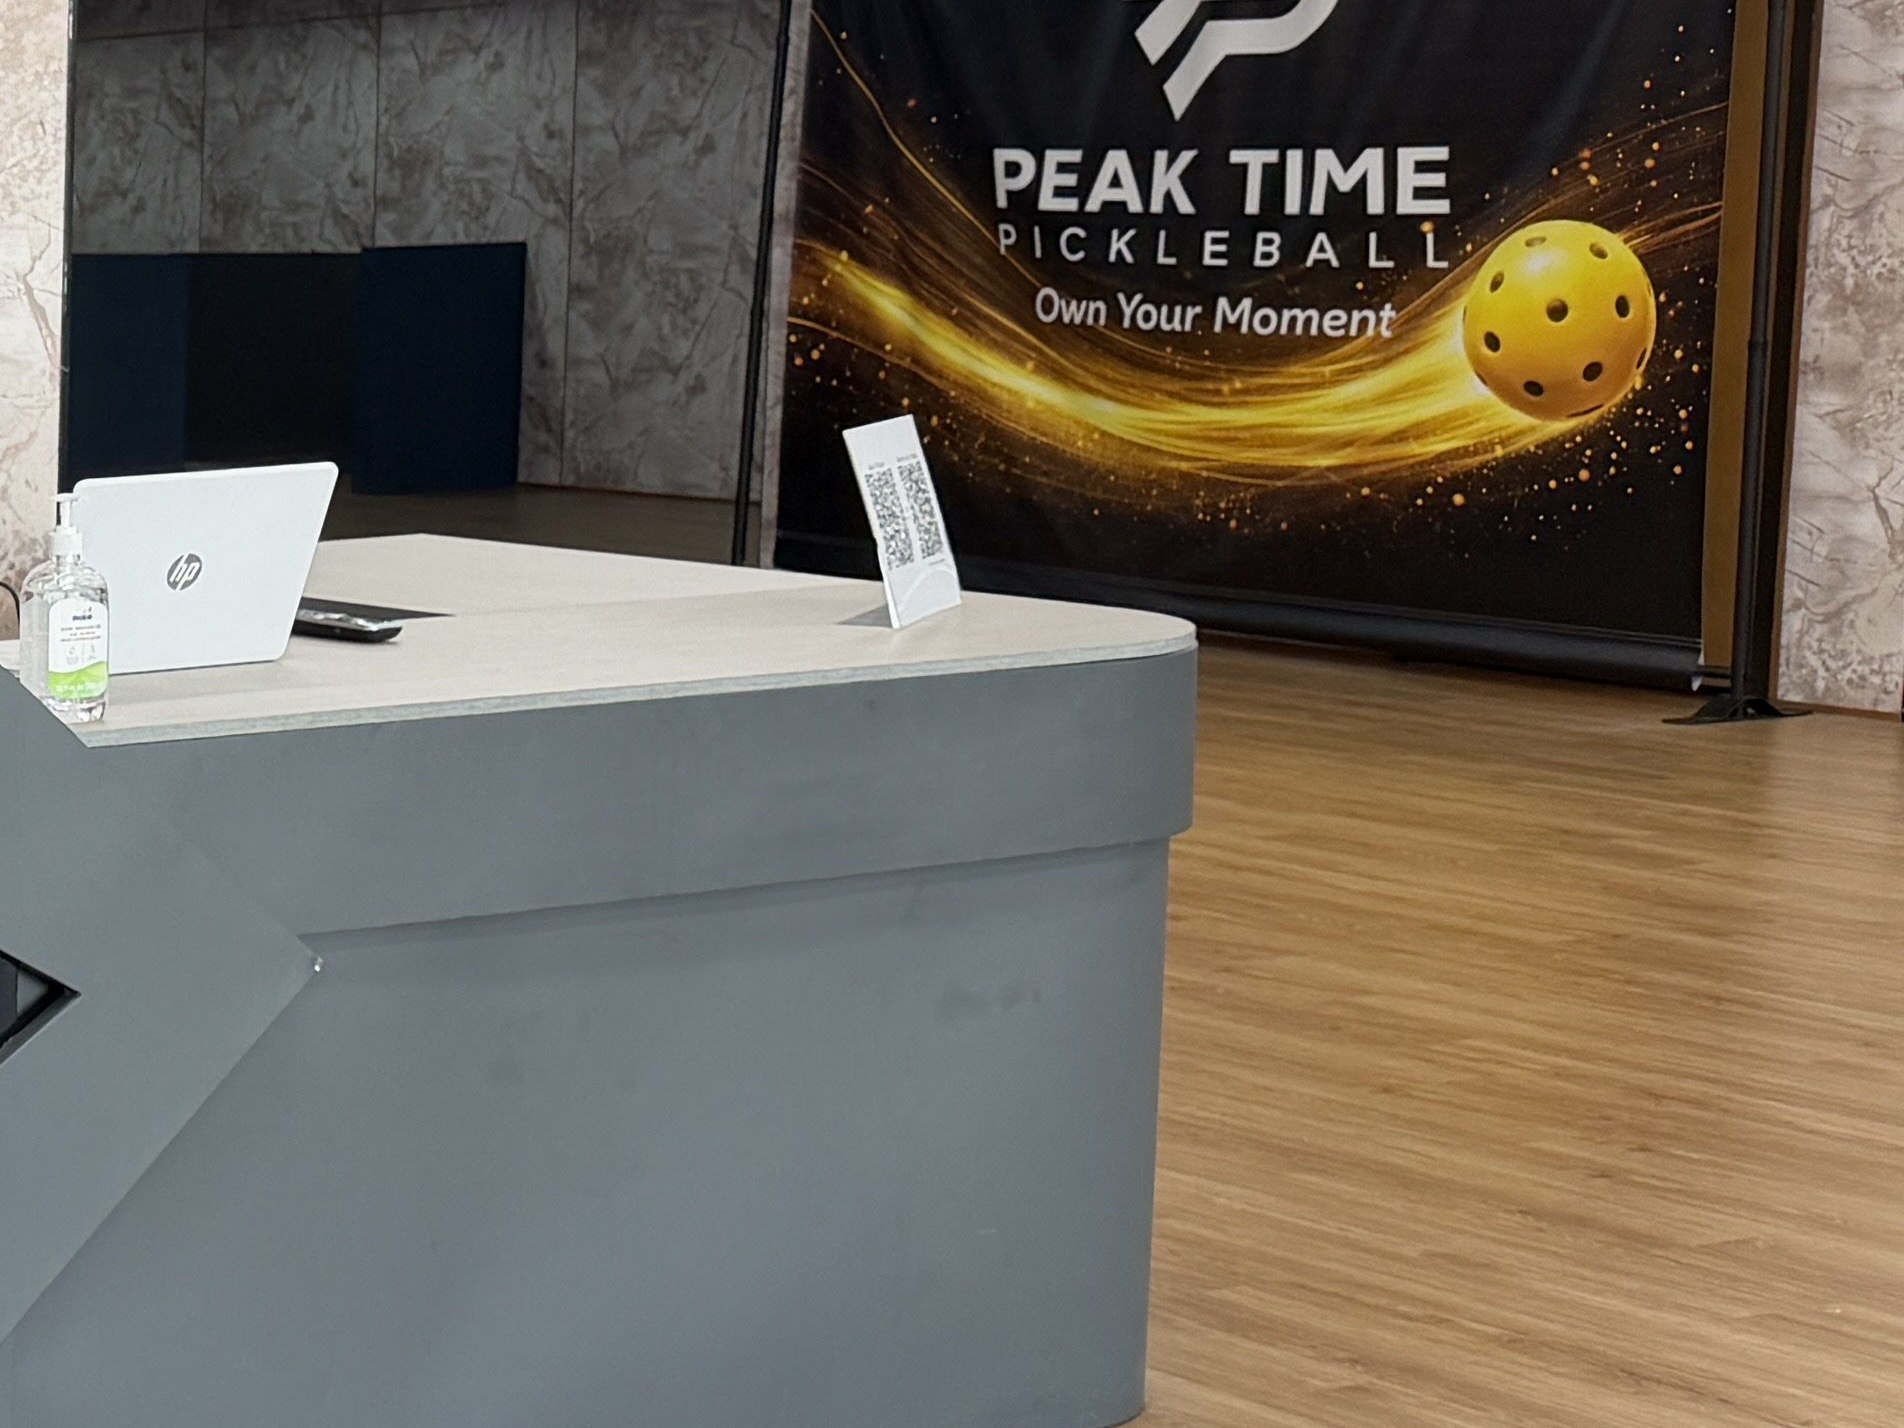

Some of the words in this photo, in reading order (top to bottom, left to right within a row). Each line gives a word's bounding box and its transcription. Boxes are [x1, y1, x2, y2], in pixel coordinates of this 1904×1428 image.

[992, 147, 1201, 217] PEAK
[1229, 145, 1452, 216] TIME
[996, 223, 1449, 270] PICKLEBALL
[1035, 286, 1108, 327] Own
[1118, 290, 1202, 333] Your
[1213, 296, 1397, 340] Moment
[169, 554, 201, 591] hp
